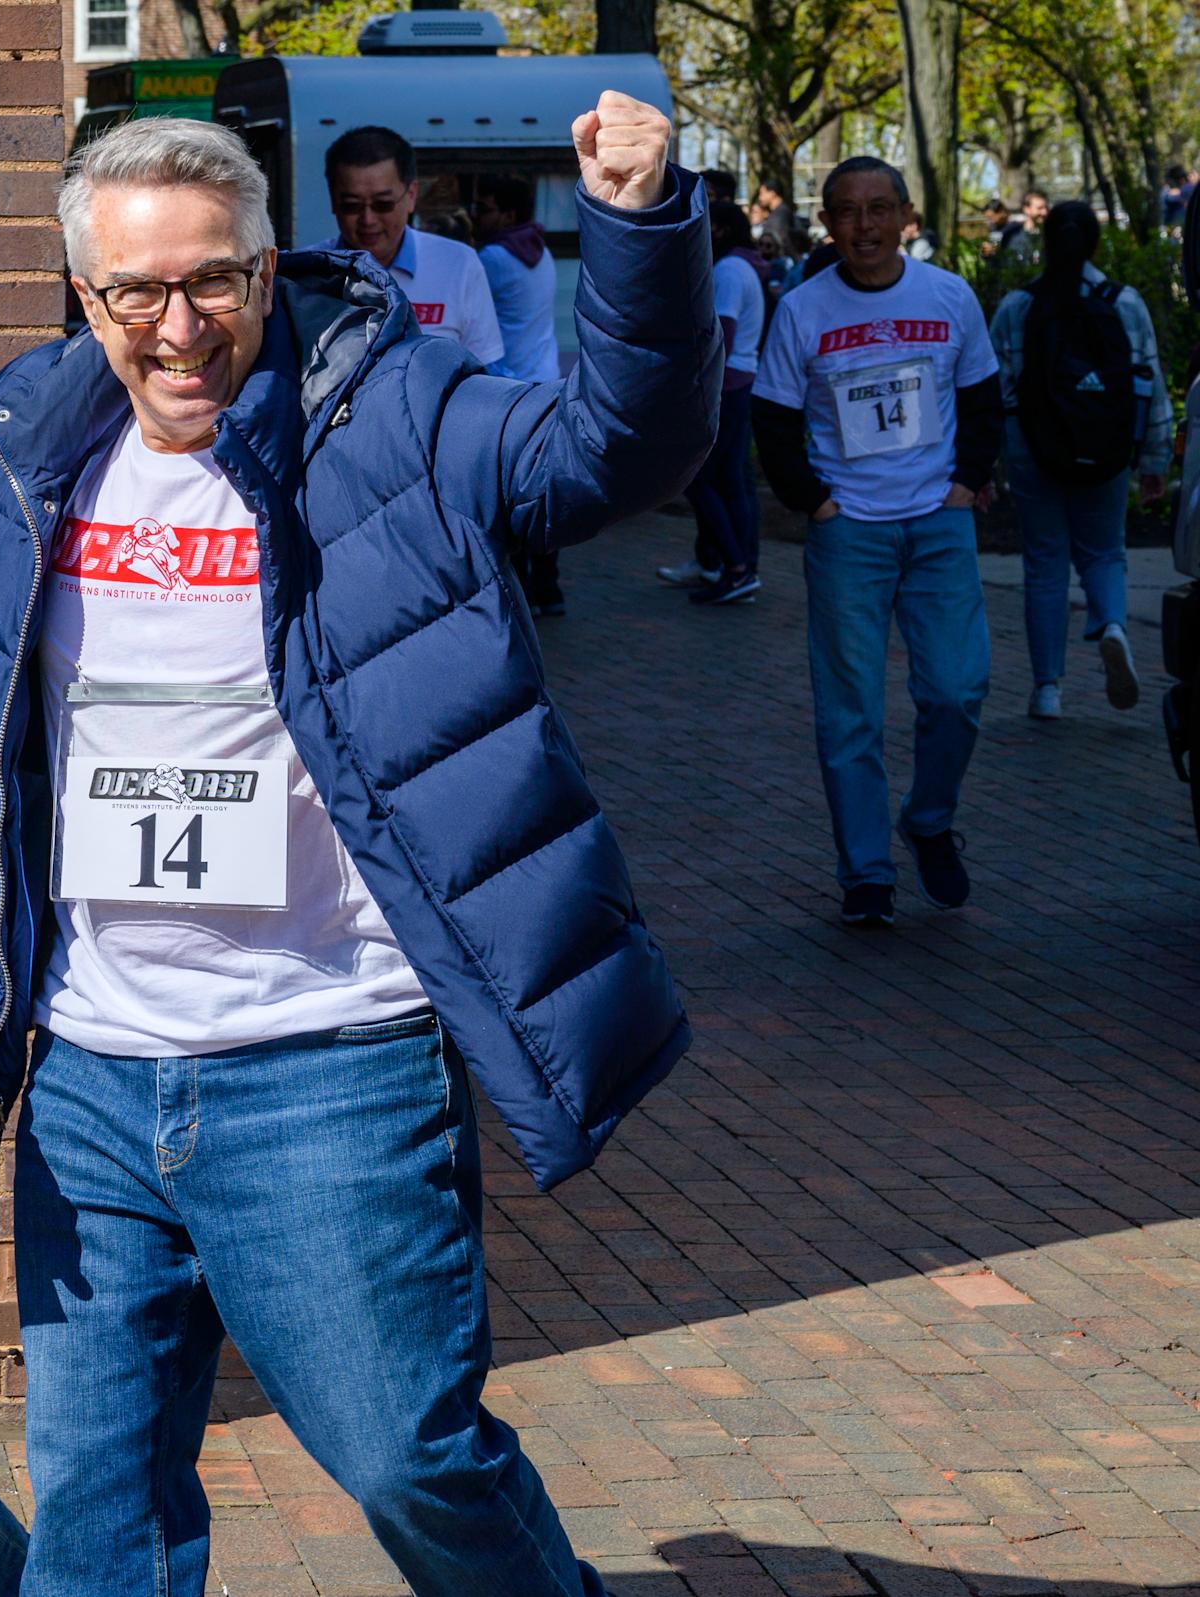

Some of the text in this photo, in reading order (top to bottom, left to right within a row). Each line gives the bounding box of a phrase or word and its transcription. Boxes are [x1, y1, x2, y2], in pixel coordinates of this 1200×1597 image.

[872, 397, 907, 433] 14
[59, 581, 252, 602] STEVENS INSTITUTE of TECHNOLOGY
[94, 770, 254, 799] DUCK DASH
[128, 812, 208, 890] 14
